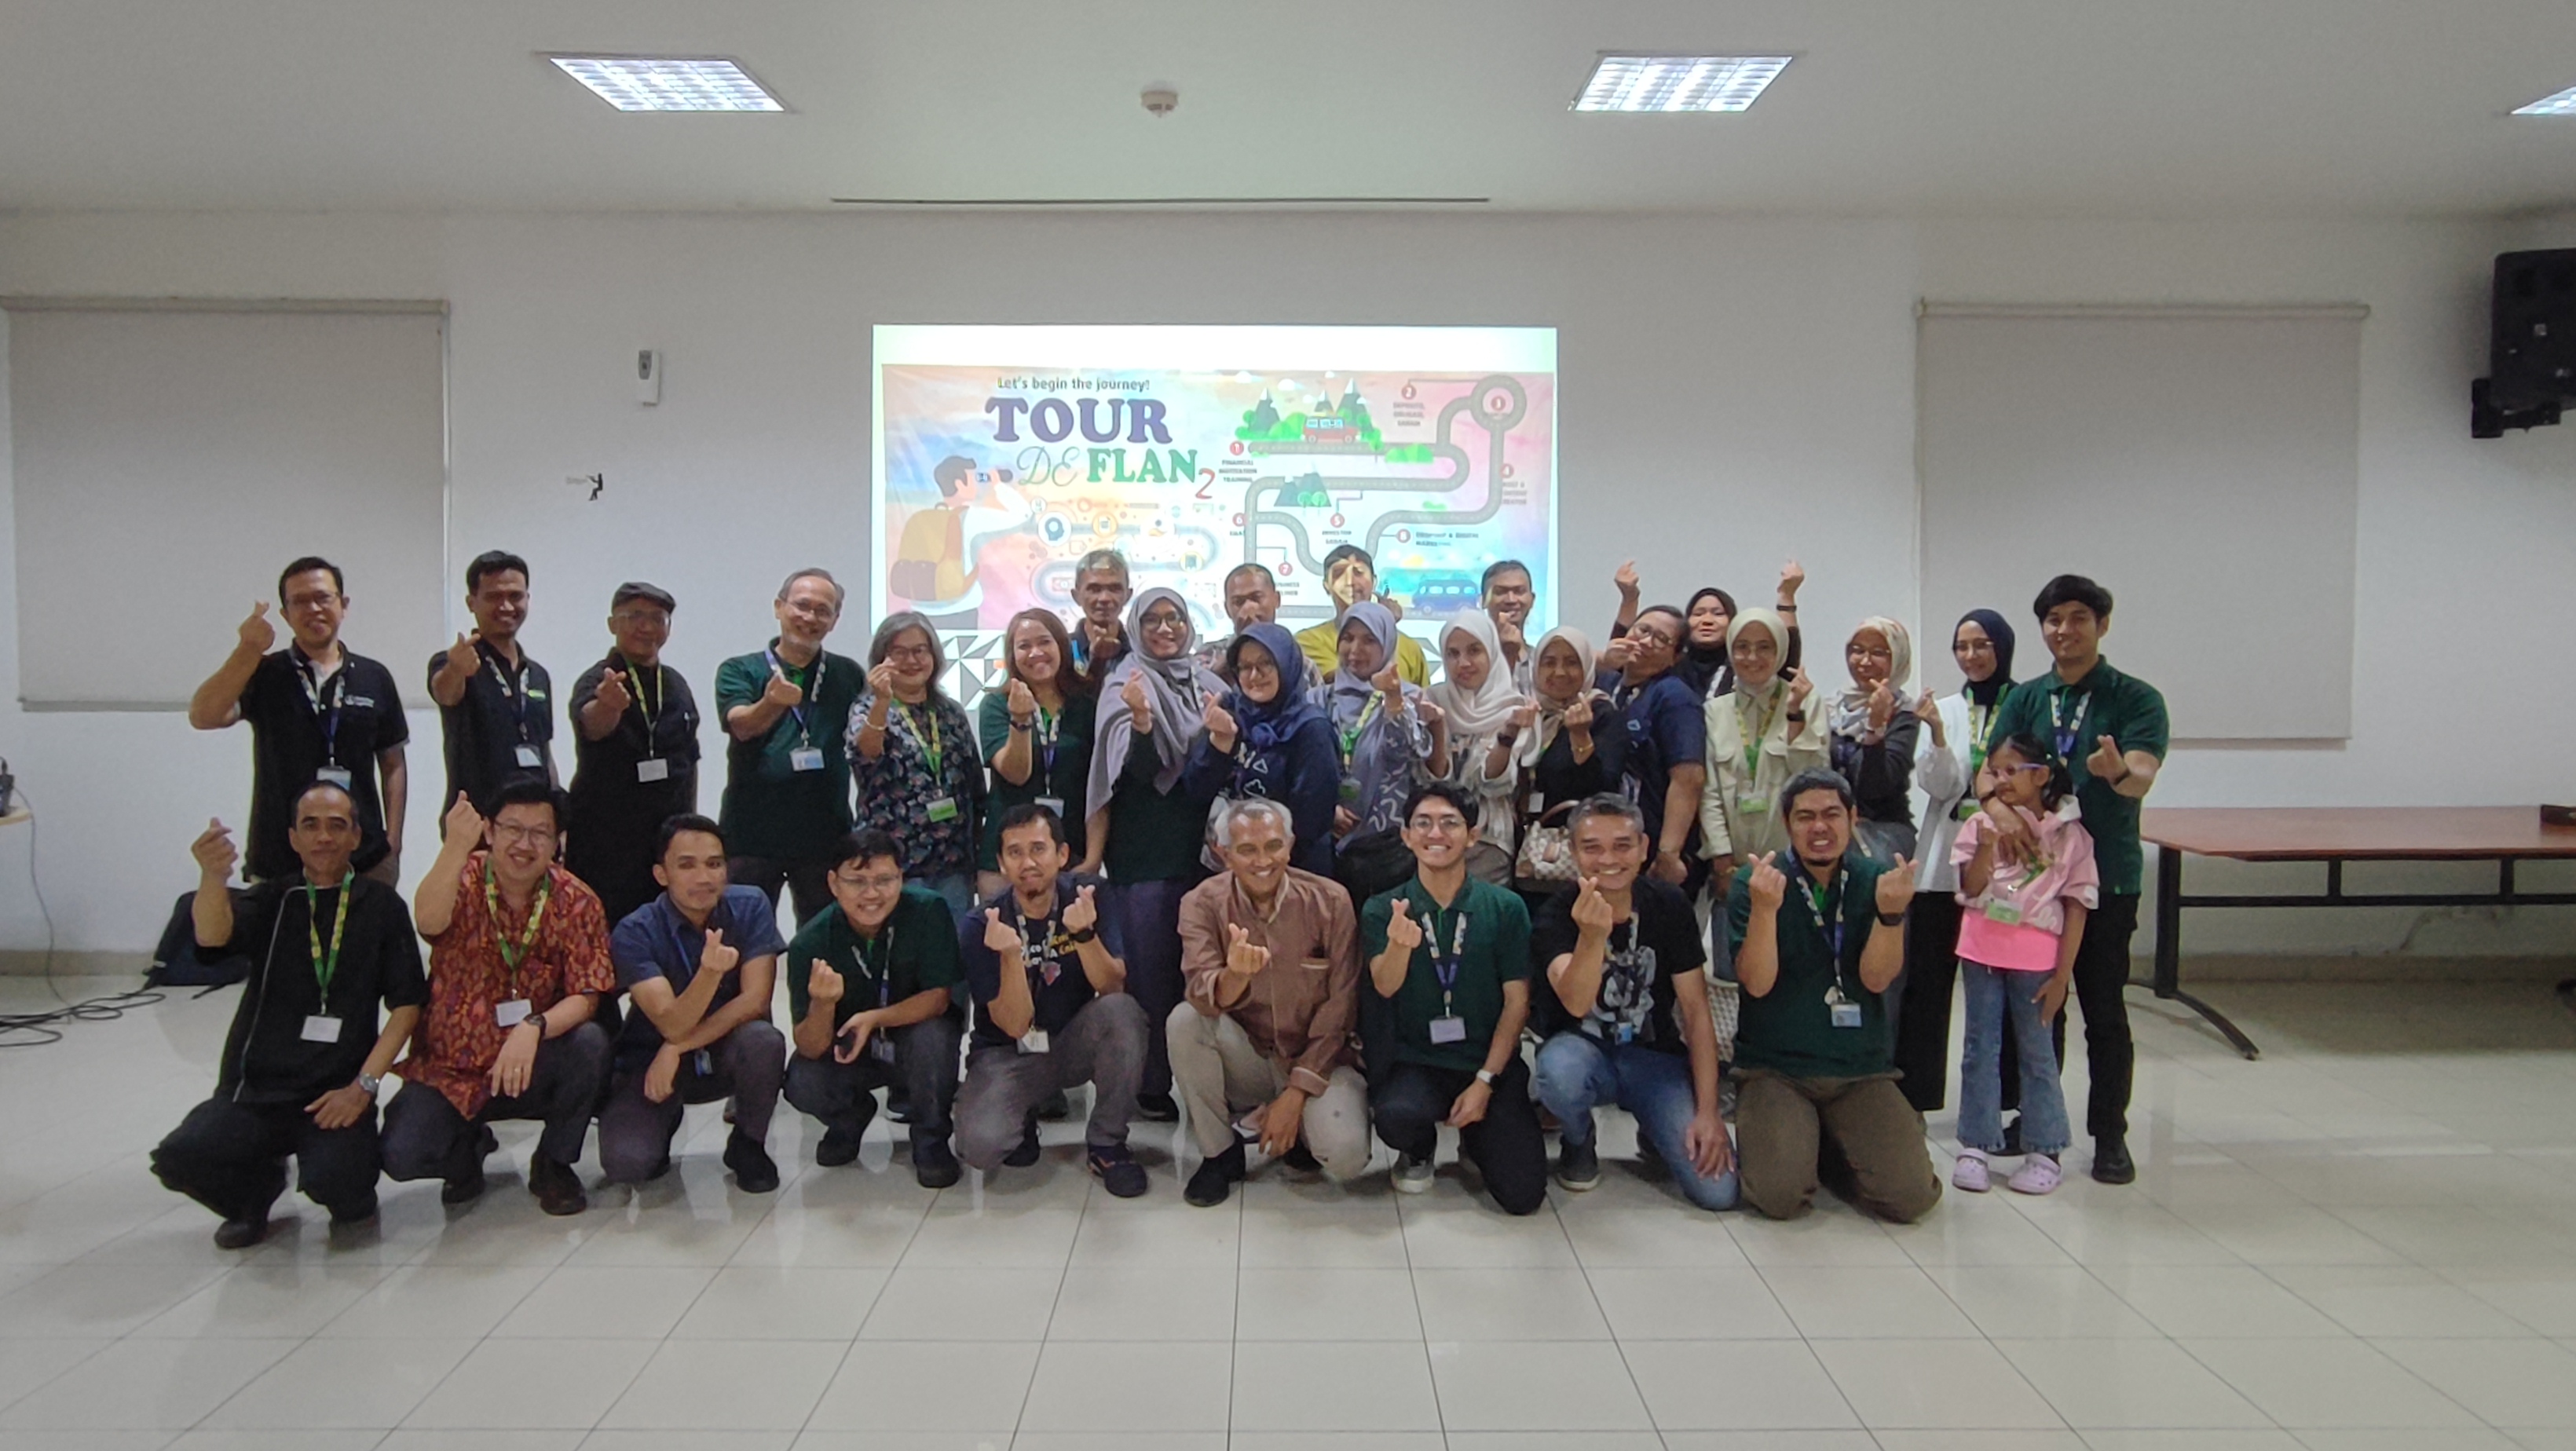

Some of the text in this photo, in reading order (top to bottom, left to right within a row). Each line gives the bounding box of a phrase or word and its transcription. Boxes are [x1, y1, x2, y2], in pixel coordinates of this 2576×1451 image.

[997, 376, 1151, 392] Let's begin the journey!
[984, 397, 1173, 444] TOUR
[1016, 445, 1217, 499] DE FLAN 2
